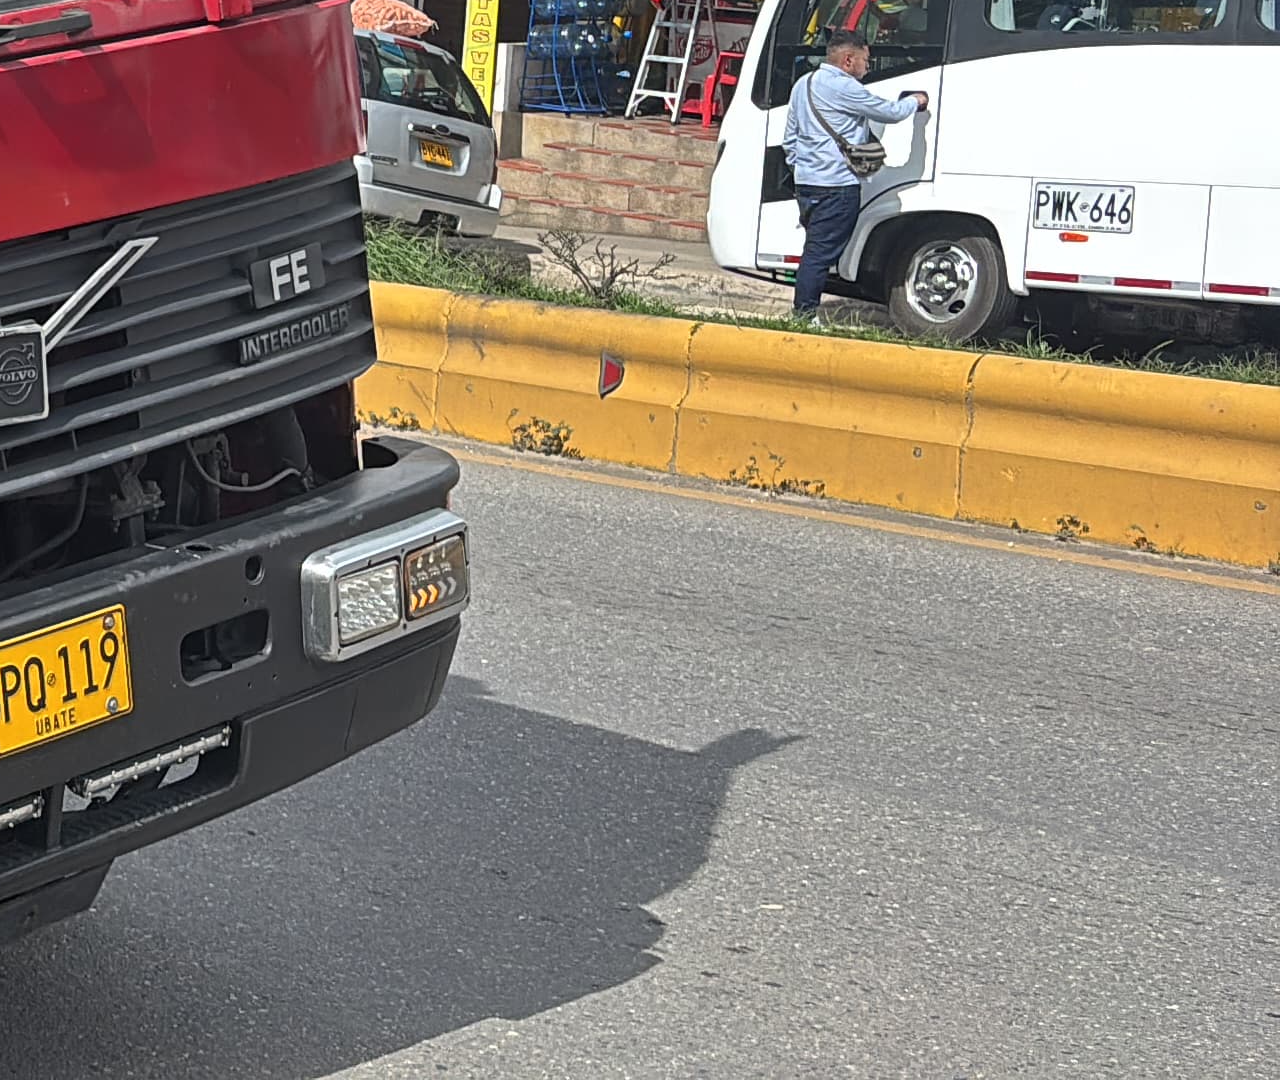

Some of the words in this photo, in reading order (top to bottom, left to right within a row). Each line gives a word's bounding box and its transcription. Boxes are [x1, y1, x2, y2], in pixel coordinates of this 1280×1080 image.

[1089, 192, 1132, 224] 646
[269, 249, 311, 301] FE
[241, 304, 351, 362] INTERCOOLER
[35, 707, 78, 736] UBATE
